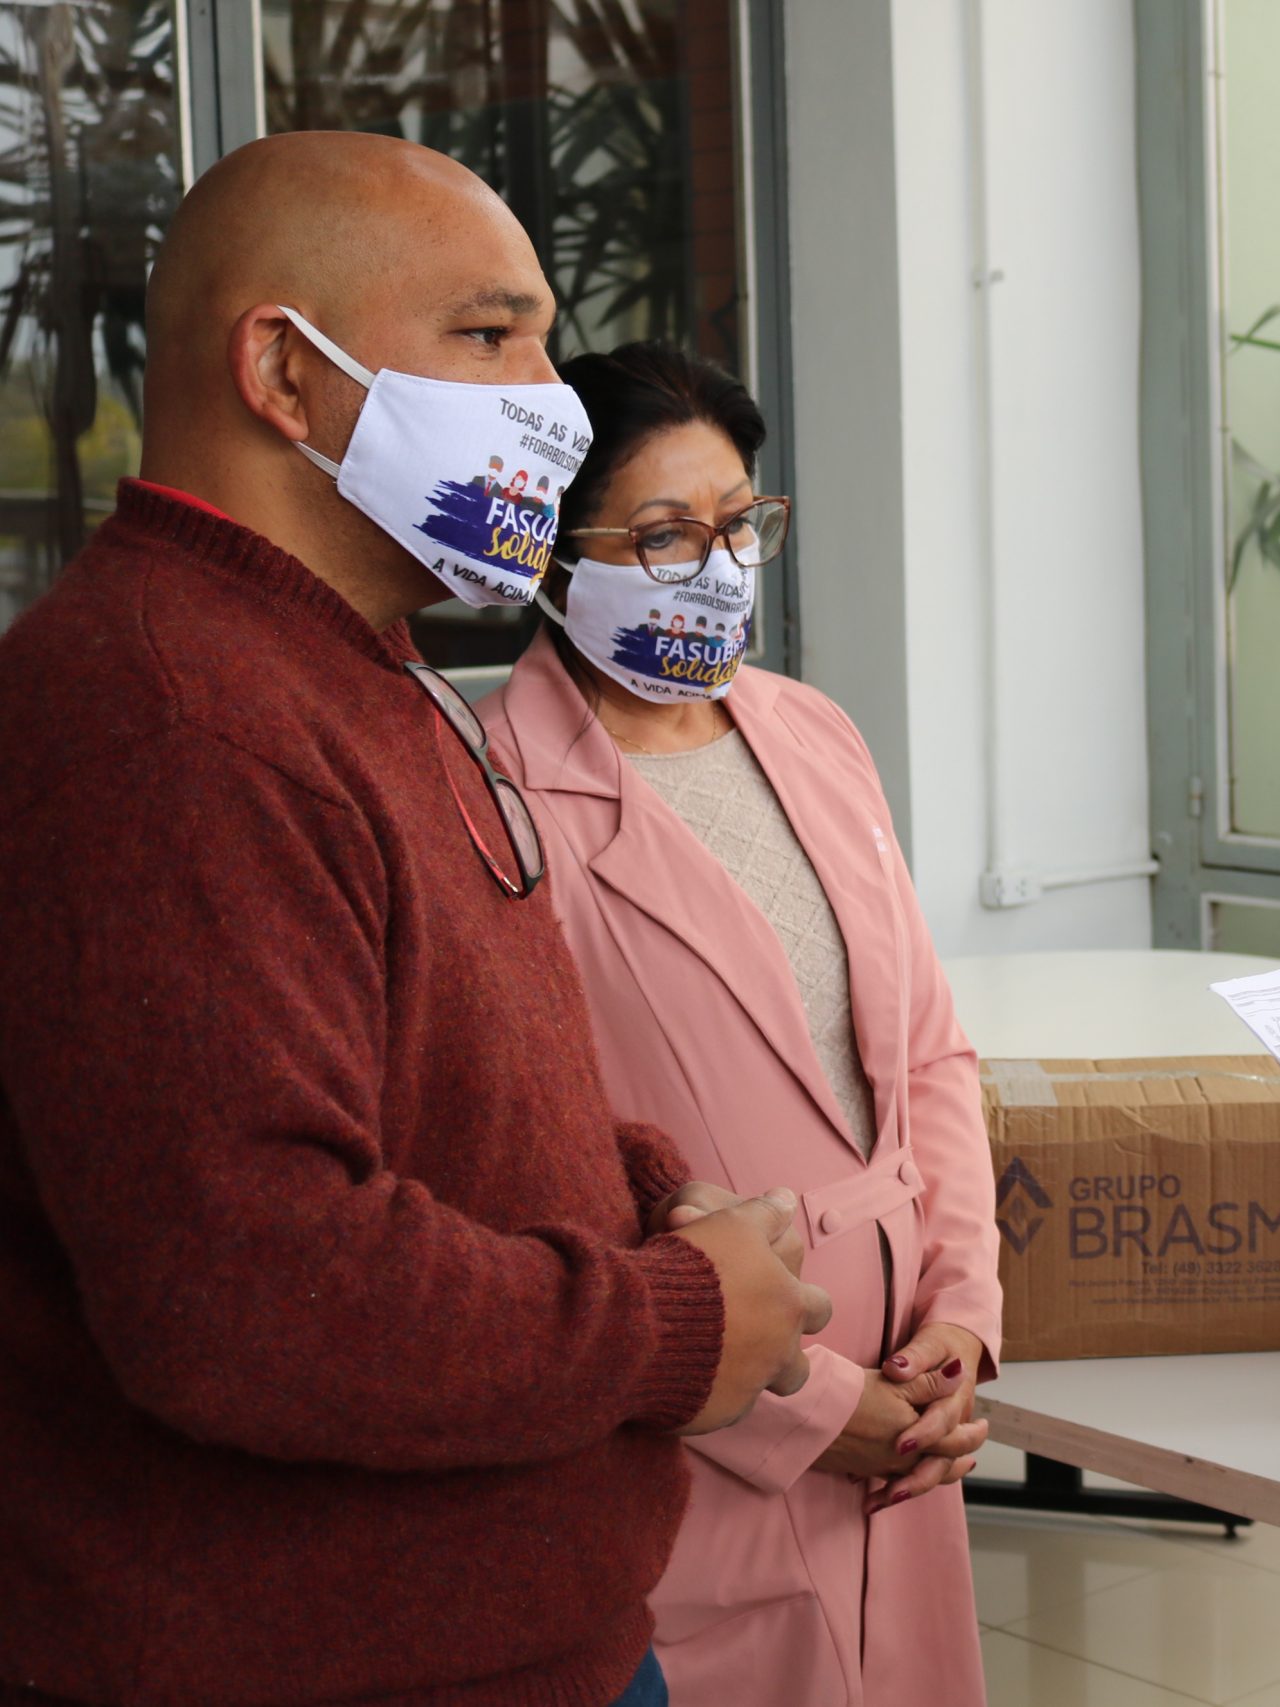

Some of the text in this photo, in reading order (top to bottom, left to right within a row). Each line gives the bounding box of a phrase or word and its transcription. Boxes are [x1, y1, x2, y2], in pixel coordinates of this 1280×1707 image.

[500, 398, 544, 432] TODAS
[547, 422, 568, 442] AS
[432, 557, 533, 606] A VIDA ACIM
[695, 577, 710, 590] AS
[630, 678, 639, 688] A
[643, 682, 672, 695] VIDA
[1068, 1174, 1182, 1202] GRUPO
[1141, 1261, 1169, 1274] Tel:
